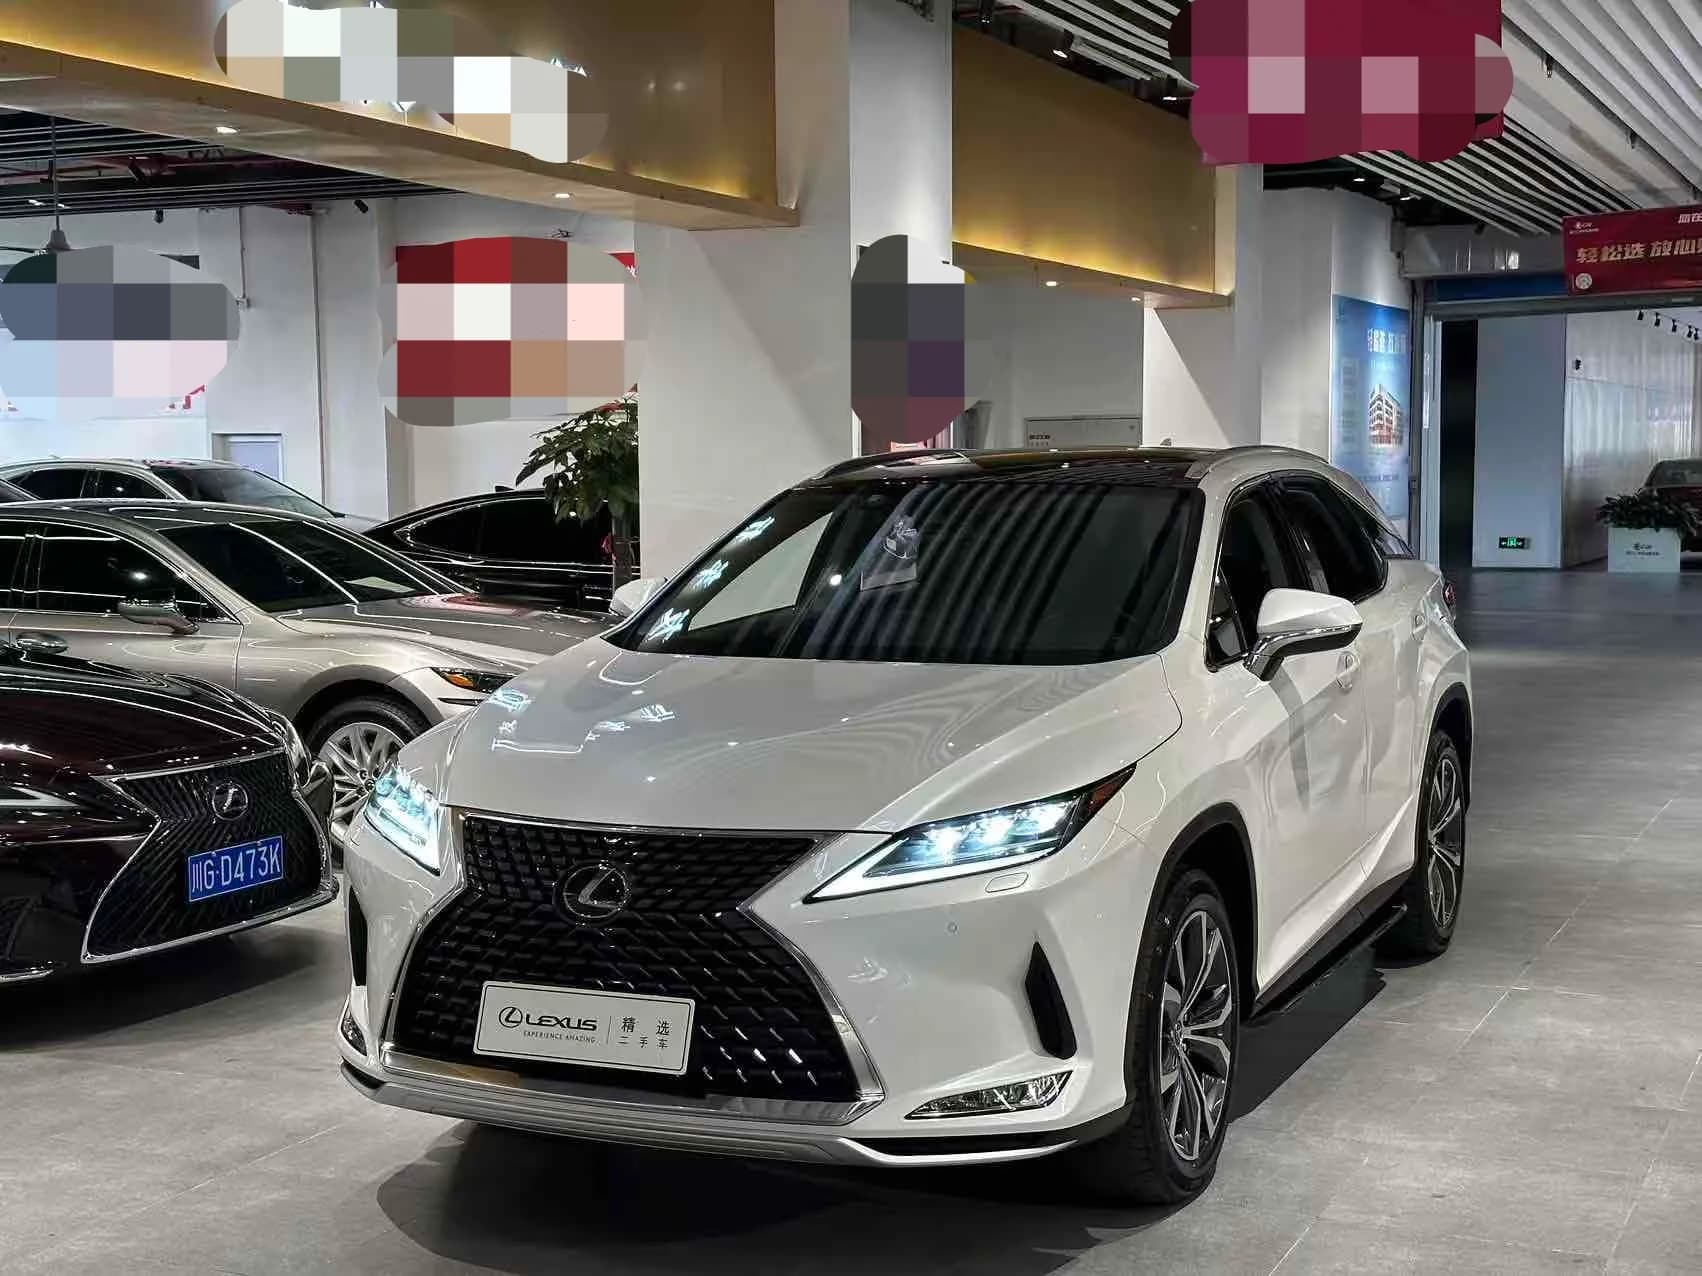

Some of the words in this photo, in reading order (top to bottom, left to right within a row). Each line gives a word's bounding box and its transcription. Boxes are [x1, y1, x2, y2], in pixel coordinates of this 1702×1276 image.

[1576, 242, 1645, 264] 轻松选
[1649, 237, 1702, 257] 放心
[525, 1013, 598, 1032] LEXUS
[620, 1016, 671, 1036] 精选
[523, 1030, 563, 1041] EXPERIENCE
[565, 1033, 596, 1044] AMAZING
[618, 1036, 669, 1049] 二手车
